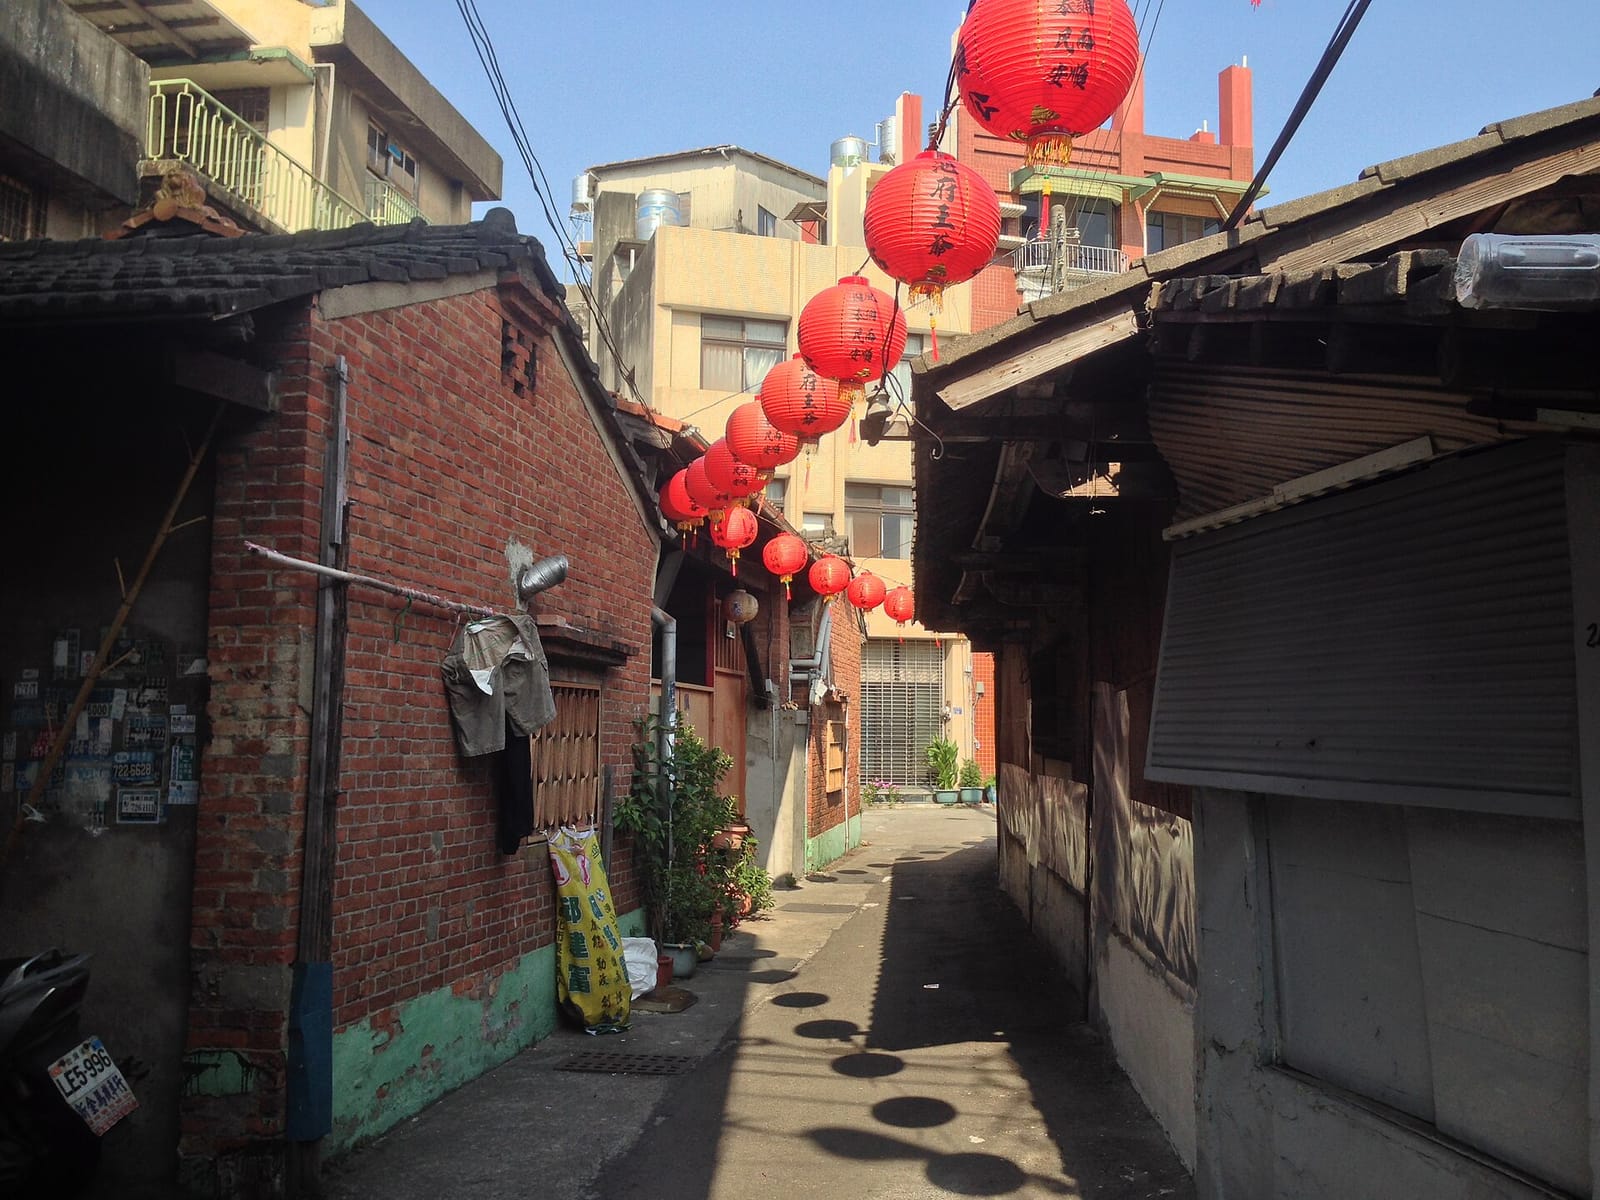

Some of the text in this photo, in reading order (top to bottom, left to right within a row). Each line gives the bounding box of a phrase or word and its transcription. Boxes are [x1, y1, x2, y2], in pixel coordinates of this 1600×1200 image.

[928, 162, 959, 257] 池府王爺
[1586, 622, 1600, 648] 2
